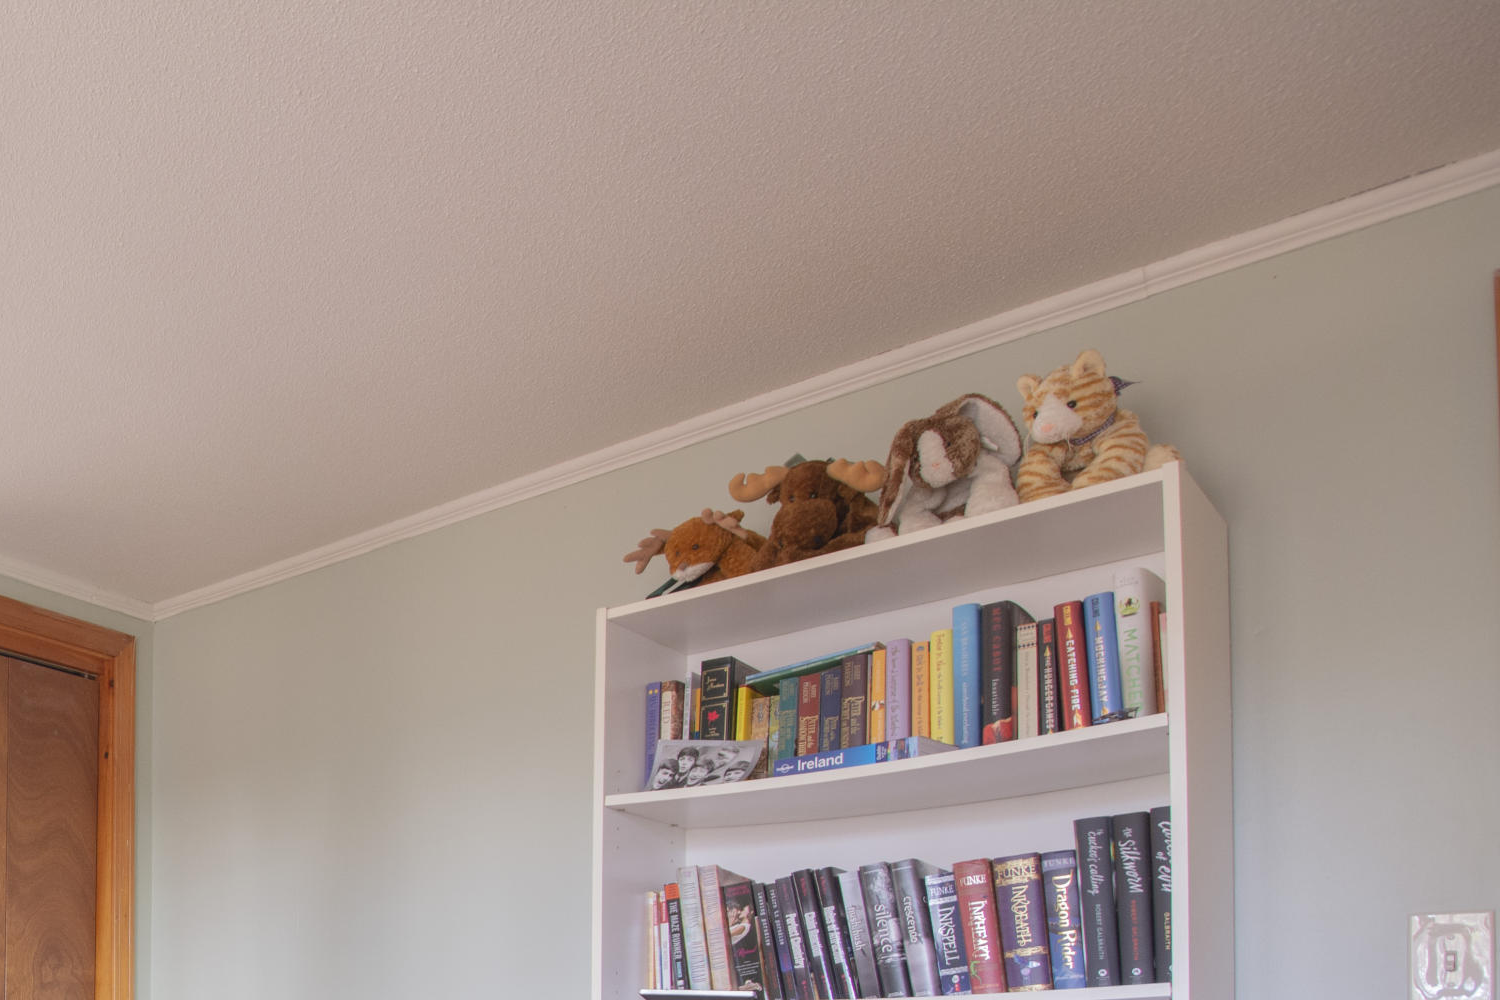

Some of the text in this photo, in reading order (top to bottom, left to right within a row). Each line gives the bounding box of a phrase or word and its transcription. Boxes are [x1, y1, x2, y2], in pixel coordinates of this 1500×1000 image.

[1065, 639, 1078, 687] CATCHING
[991, 678, 1000, 716] Insatiable
[797, 753, 844, 772] Ireland
[960, 874, 987, 886] FUNKE
[997, 865, 1036, 880] FUNKE
[1087, 863, 1105, 896] calling
[669, 901, 677, 915] THE
[670, 915, 680, 933] MAZE
[903, 895, 918, 943] crescendo
[1052, 869, 1077, 970] Dragon Rider
[671, 933, 682, 961] RUNNER
[785, 912, 805, 969] Perfect Chemistry
[937, 904, 961, 965] INKSPELL
